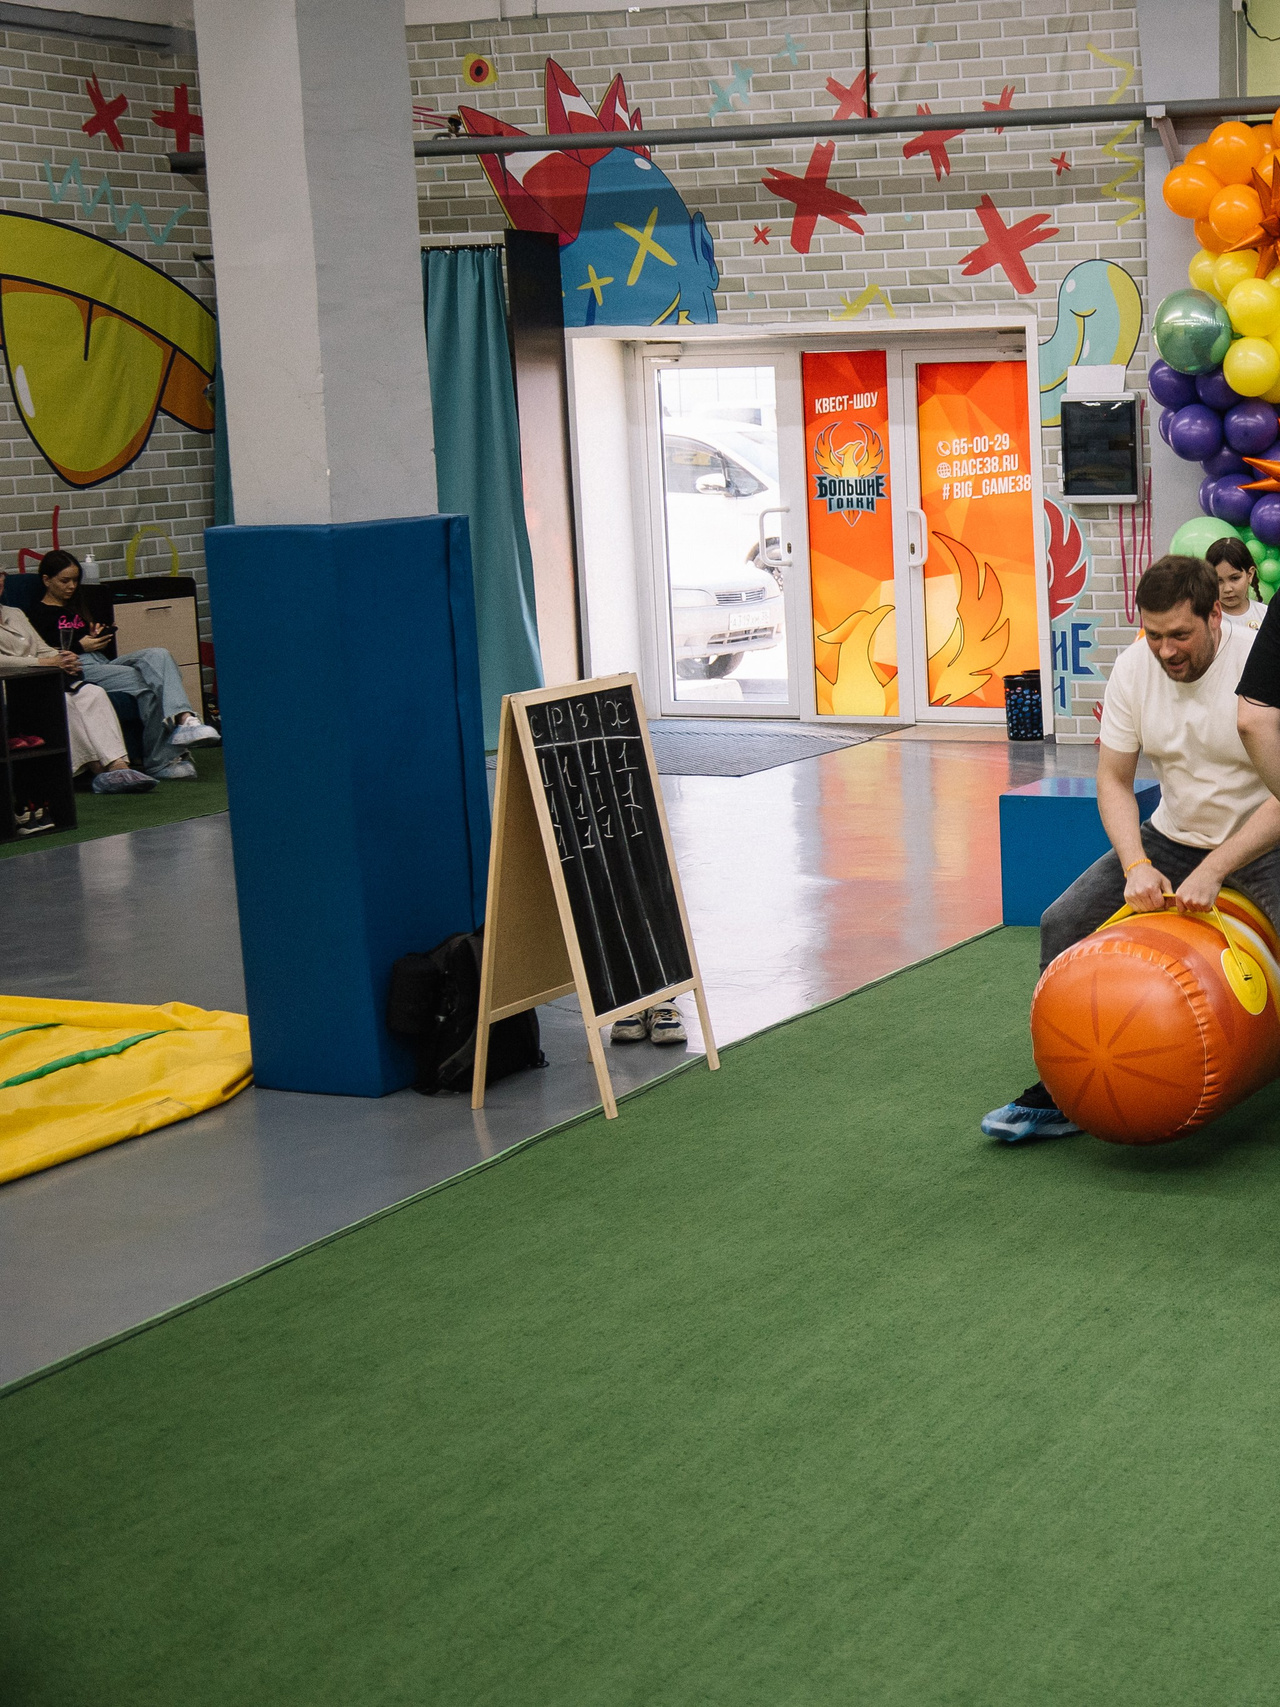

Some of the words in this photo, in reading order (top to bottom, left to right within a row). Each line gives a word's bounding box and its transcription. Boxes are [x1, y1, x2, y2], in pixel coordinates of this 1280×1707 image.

[814, 391, 879, 415] КВЕСТ-ШОУ
[952, 433, 1010, 456] 65-00-29
[952, 453, 1019, 478] RACE38.RU
[815, 474, 886, 499] БОЛЬШИЕ
[828, 497, 876, 512] ГОНКИ
